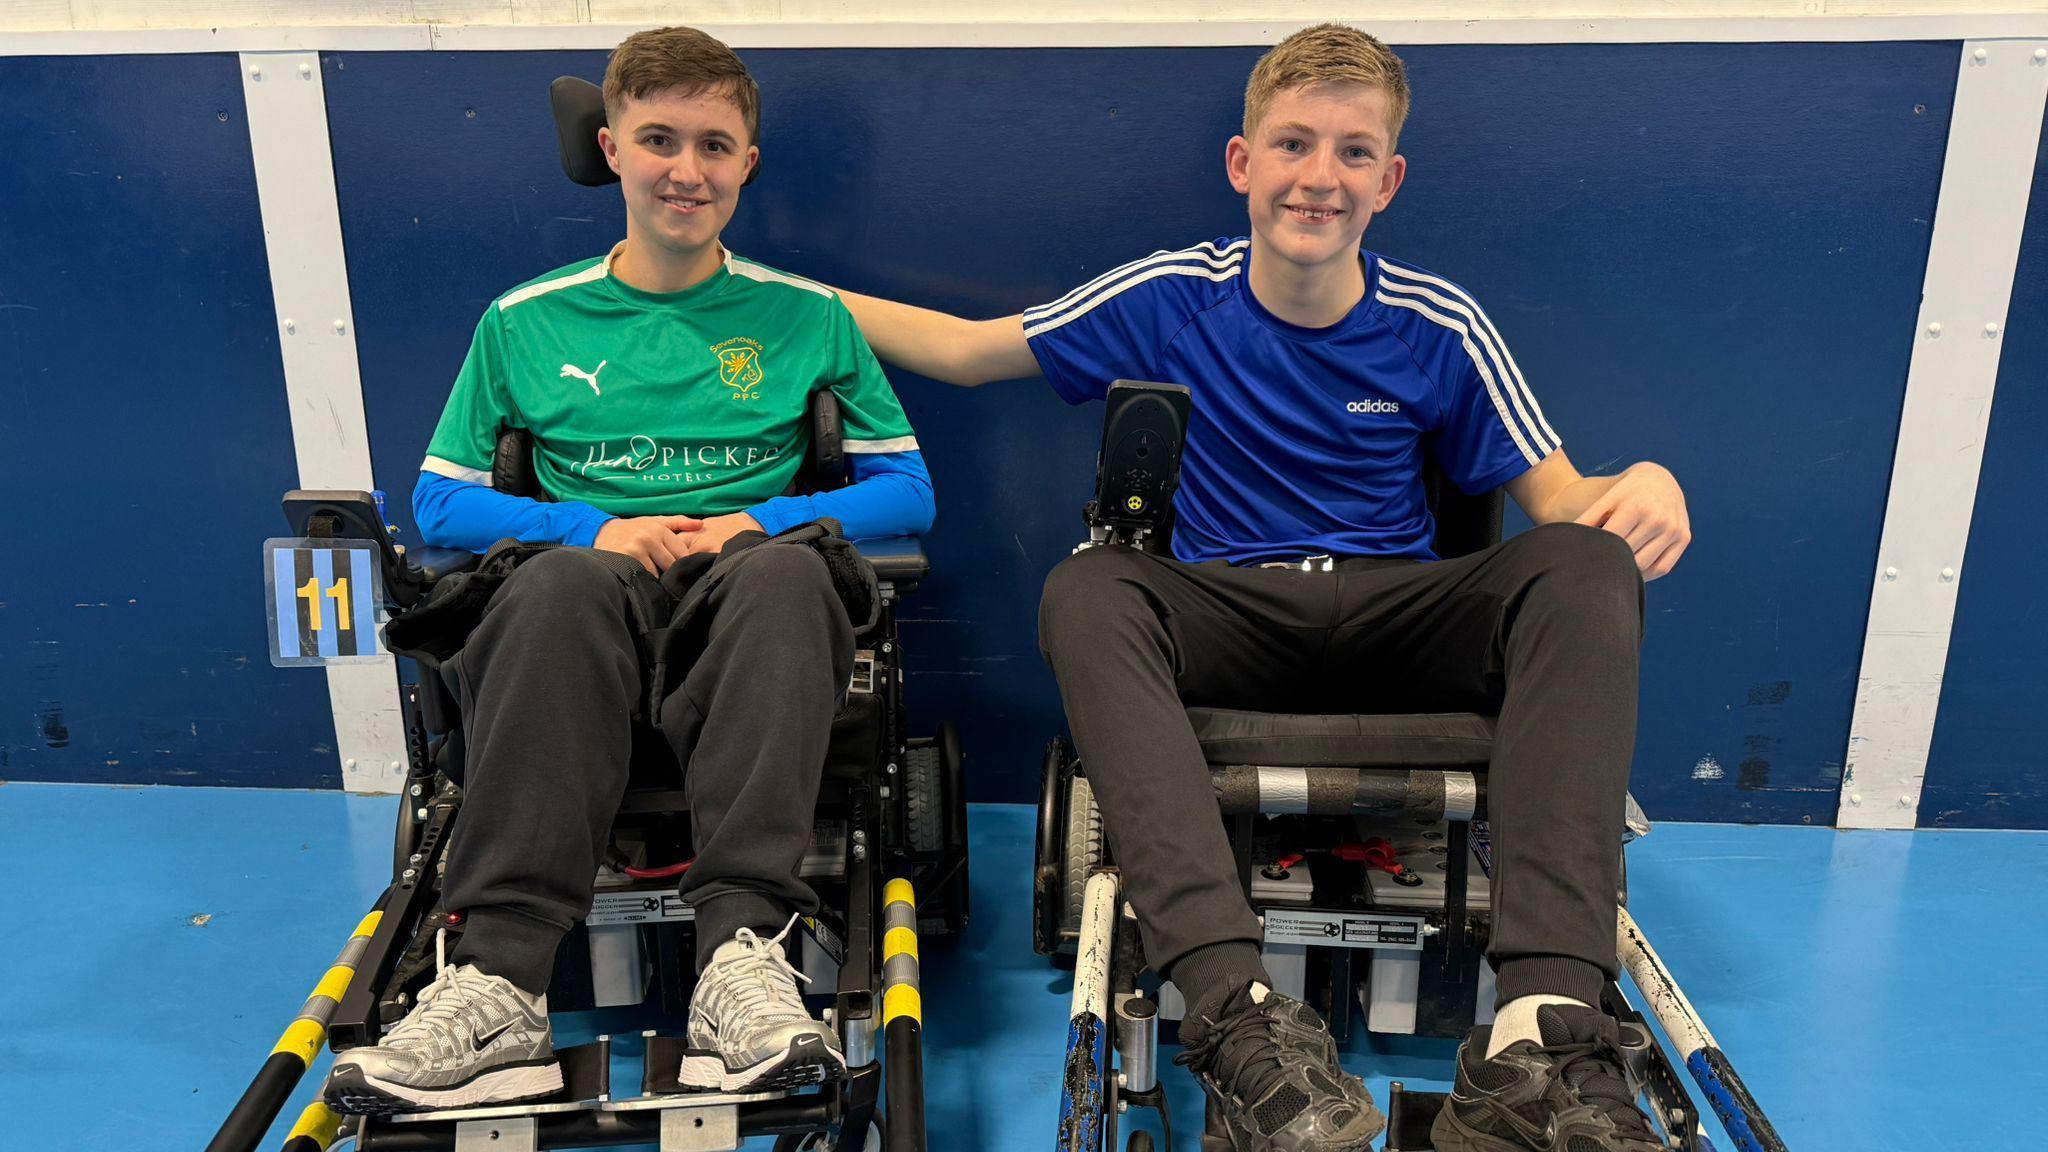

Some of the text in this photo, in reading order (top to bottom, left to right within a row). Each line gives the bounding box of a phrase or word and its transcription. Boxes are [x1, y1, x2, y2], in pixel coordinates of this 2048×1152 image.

[709, 337, 764, 353] Sevenoaks
[1346, 399, 1400, 413] adidas
[296, 577, 350, 631] 11
